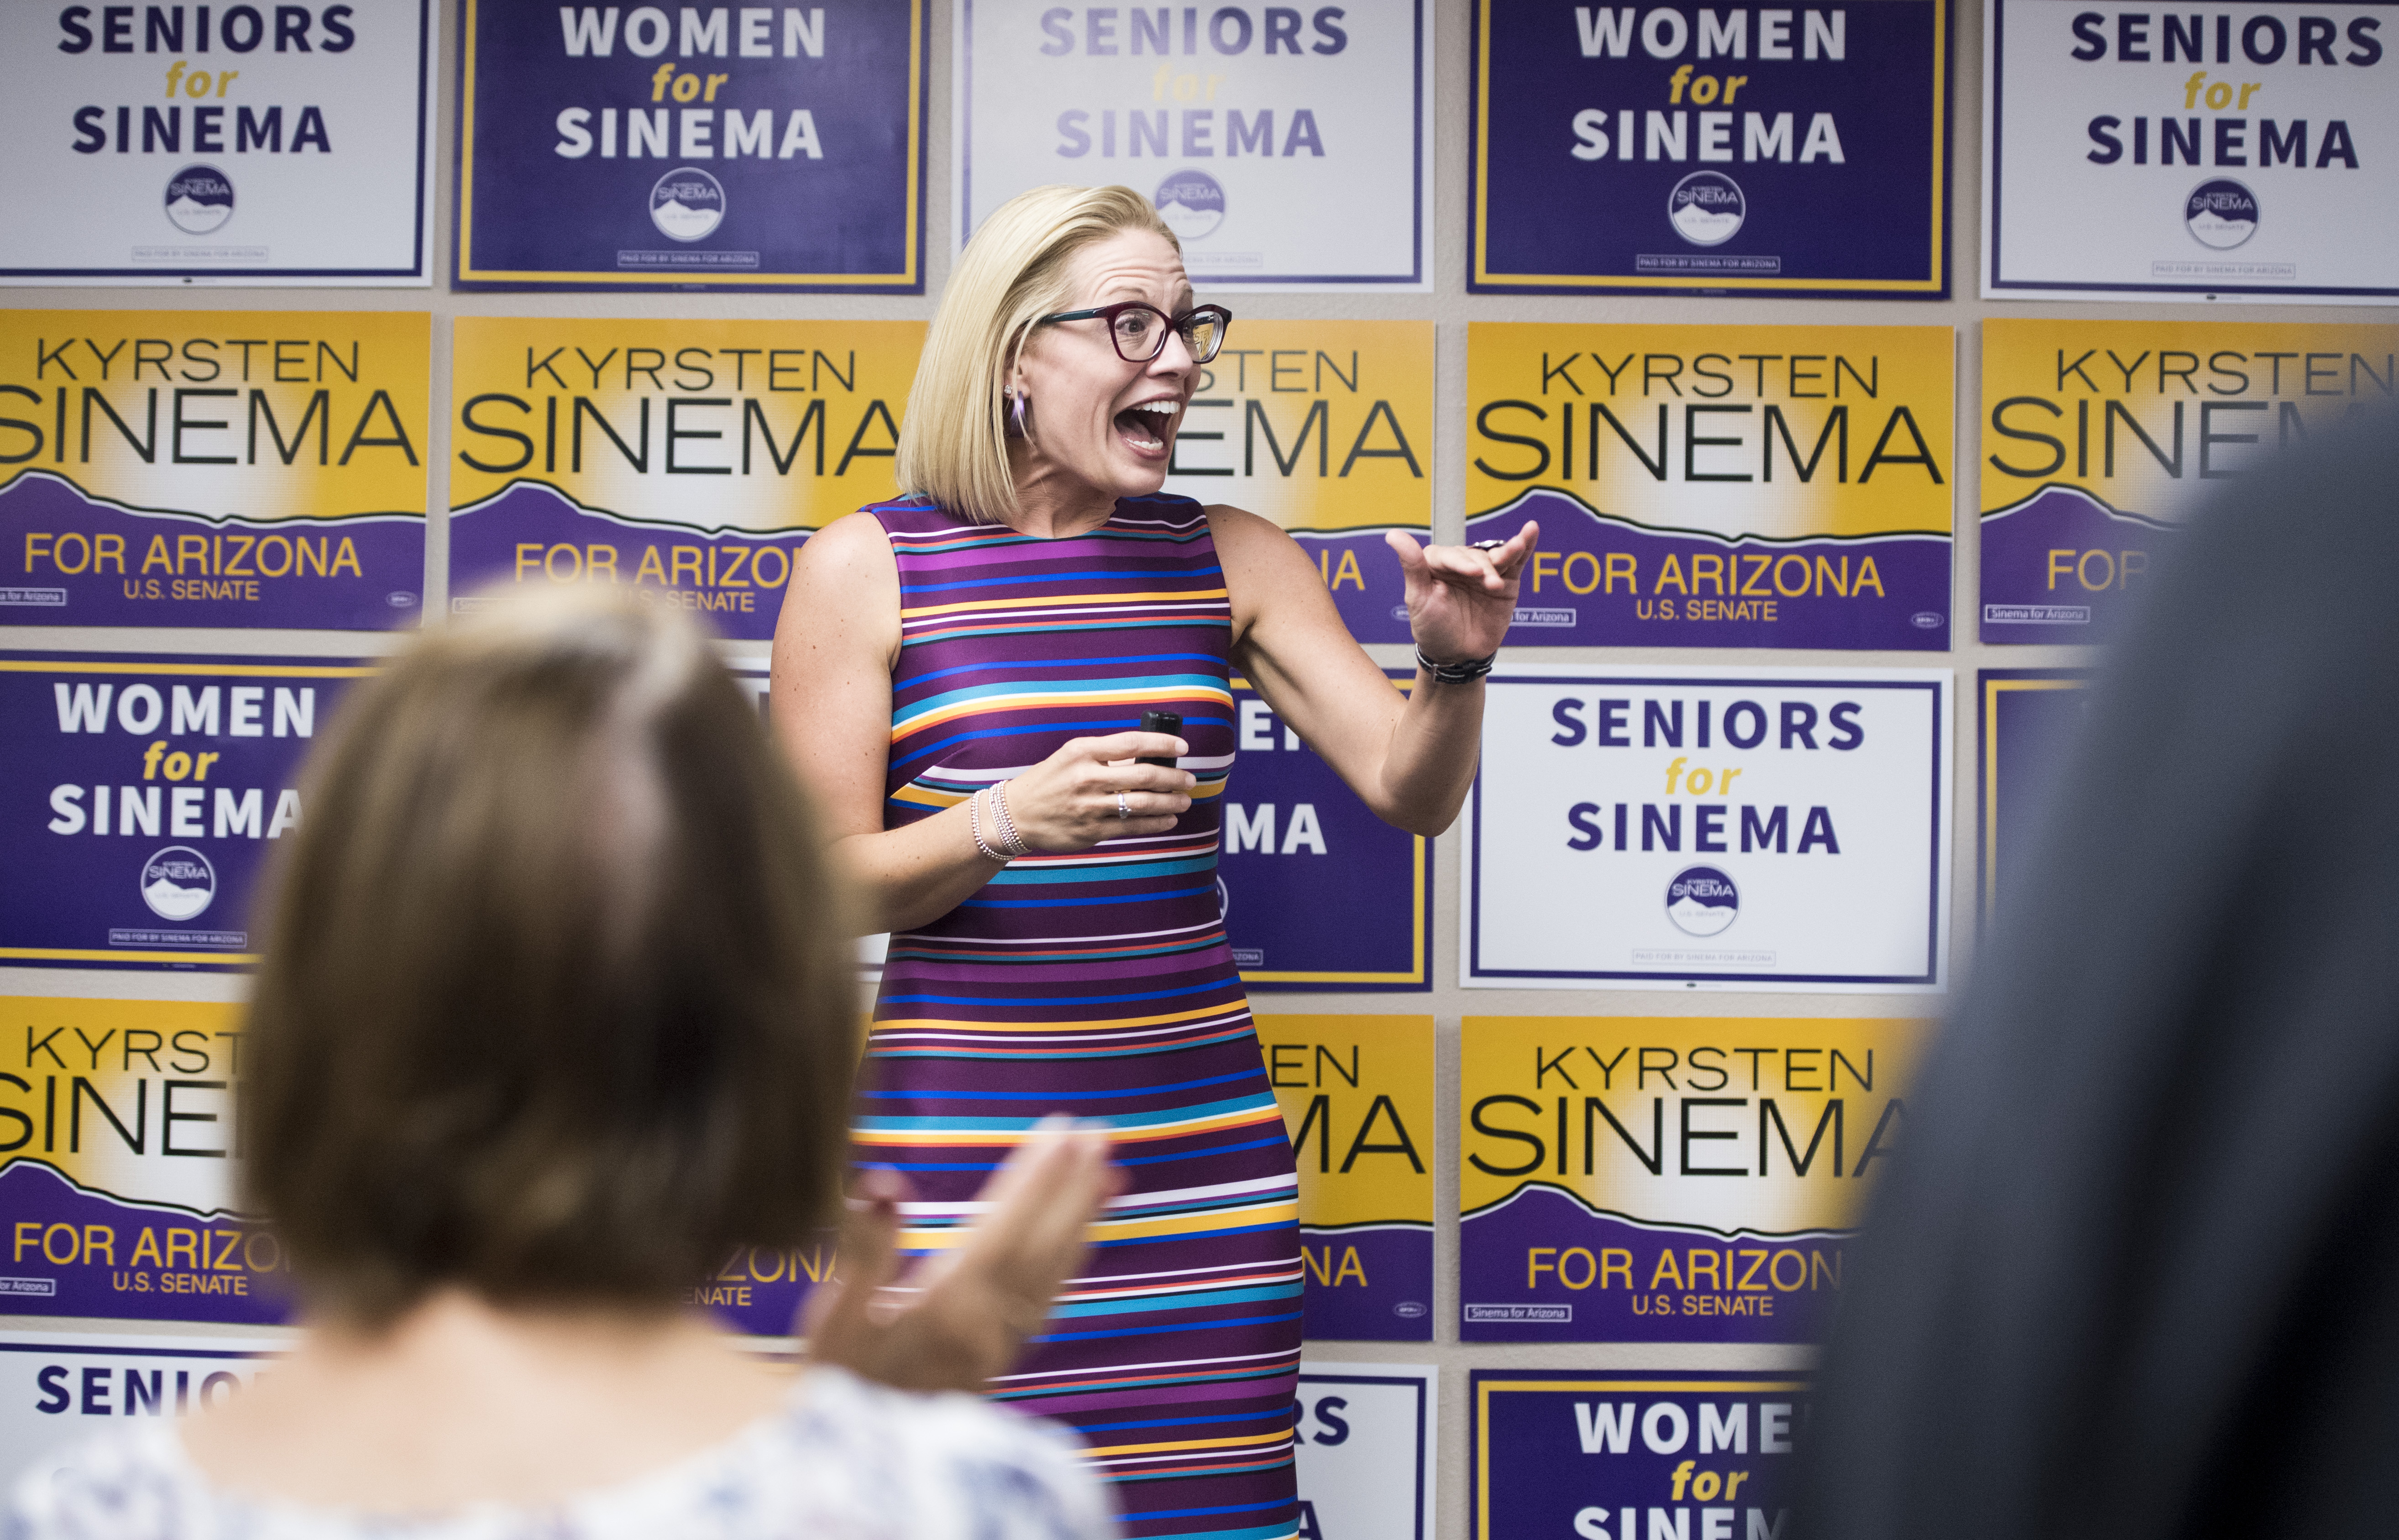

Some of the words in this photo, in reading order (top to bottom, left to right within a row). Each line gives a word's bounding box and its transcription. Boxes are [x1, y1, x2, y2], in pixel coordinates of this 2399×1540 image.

[58, 5, 355, 53] SENIORS
[560, 7, 824, 57] WOMEN
[1039, 6, 1347, 57] SENIORS
[1575, 7, 1846, 60] WOMEN
[2071, 11, 2383, 67] SENIORS
[165, 61, 239, 98] for
[652, 63, 727, 103] for
[1154, 62, 1225, 102] for
[1670, 65, 1748, 105] for
[2184, 71, 2261, 110] for
[71, 106, 331, 153] SINEMA
[555, 107, 822, 158] SINEMA
[1056, 109, 1325, 158] SINEMA
[1571, 109, 1846, 164] SINEMA
[2087, 115, 2359, 168] SINEMA
[1677, 191, 1738, 204] SINEMA
[2192, 196, 2253, 210] SINEMA
[37, 338, 358, 383] KYRSTEN
[526, 347, 854, 392] KYRSTEN
[1542, 352, 1877, 398] KYRSTEN
[2058, 349, 2395, 396] KYRSTEN
[458, 393, 901, 476] SINEMA
[1474, 399, 1944, 484] SINEMA
[25, 532, 126, 575] FOR
[141, 534, 362, 577] ARIZONA
[515, 543, 618, 586] FOR
[634, 545, 802, 589] ARIZO
[1533, 552, 1638, 595] FOR
[1654, 553, 1885, 598] ARIZONA
[124, 579, 165, 600] U.S.
[171, 579, 260, 601] SENATE
[1637, 599, 1680, 620] U.S.
[1686, 600, 1778, 621] SENATE
[54, 683, 315, 737] WOMEN
[1551, 697, 1865, 751] SENIORS
[143, 741, 219, 781] for
[1665, 757, 1742, 796] for
[48, 783, 305, 839] SINEMA
[1566, 802, 1840, 855] SINEMA
[1672, 883, 1734, 897] SINEMA
[1536, 1047, 1872, 1092] KYRSTEN
[14, 1222, 115, 1266] FOR
[113, 1271, 154, 1292] U.S.
[161, 1273, 247, 1296] SENATE
[1528, 1247, 1634, 1289] FOR
[1510, 1307, 1525, 1318] for
[1527, 1307, 1565, 1319] Arizona
[1632, 1295, 1676, 1316] U.S.
[1682, 1296, 1774, 1316] SENATE
[1671, 1460, 1749, 1501] for
